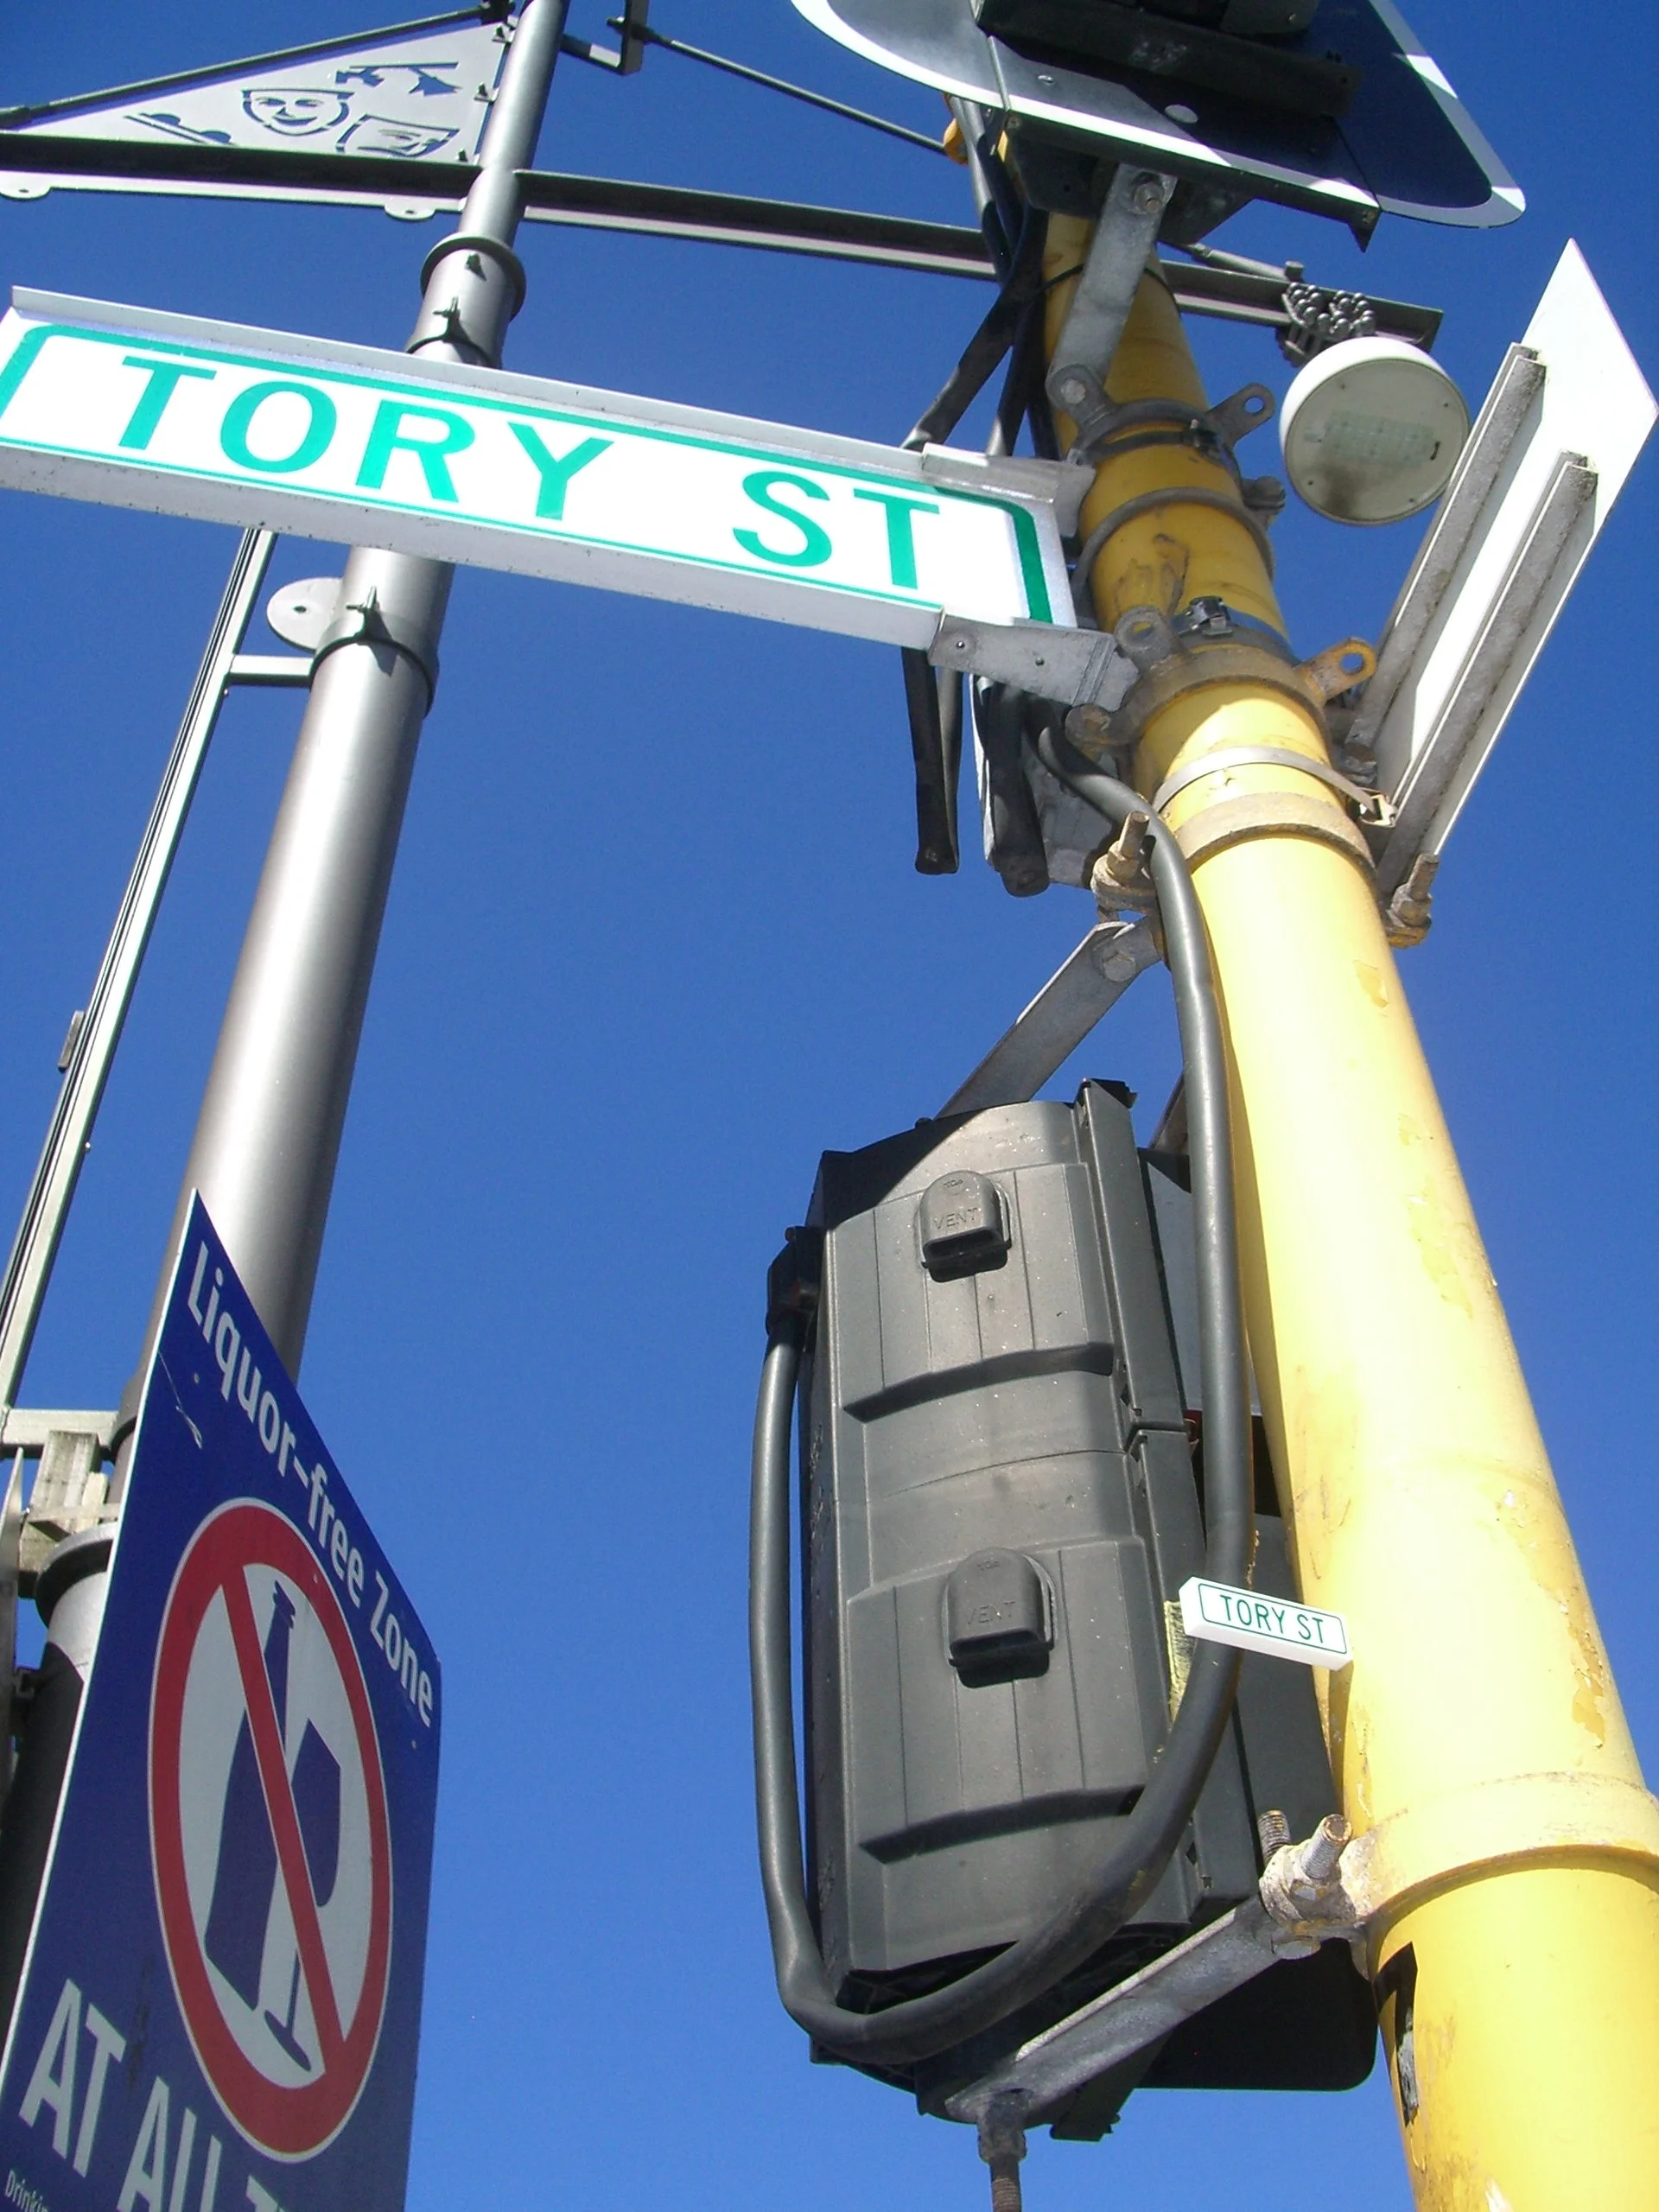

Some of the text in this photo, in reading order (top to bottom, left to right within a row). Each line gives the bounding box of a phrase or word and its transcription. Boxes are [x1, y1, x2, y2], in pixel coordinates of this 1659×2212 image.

[116, 354, 940, 590] TORY ST
[932, 1206, 980, 1230] VENT
[187, 1240, 433, 1728] Liquor-free Zone
[962, 1601, 1017, 1625] VENT
[1219, 1594, 1325, 1643] TORY ST
[18, 1978, 127, 2177] AT
